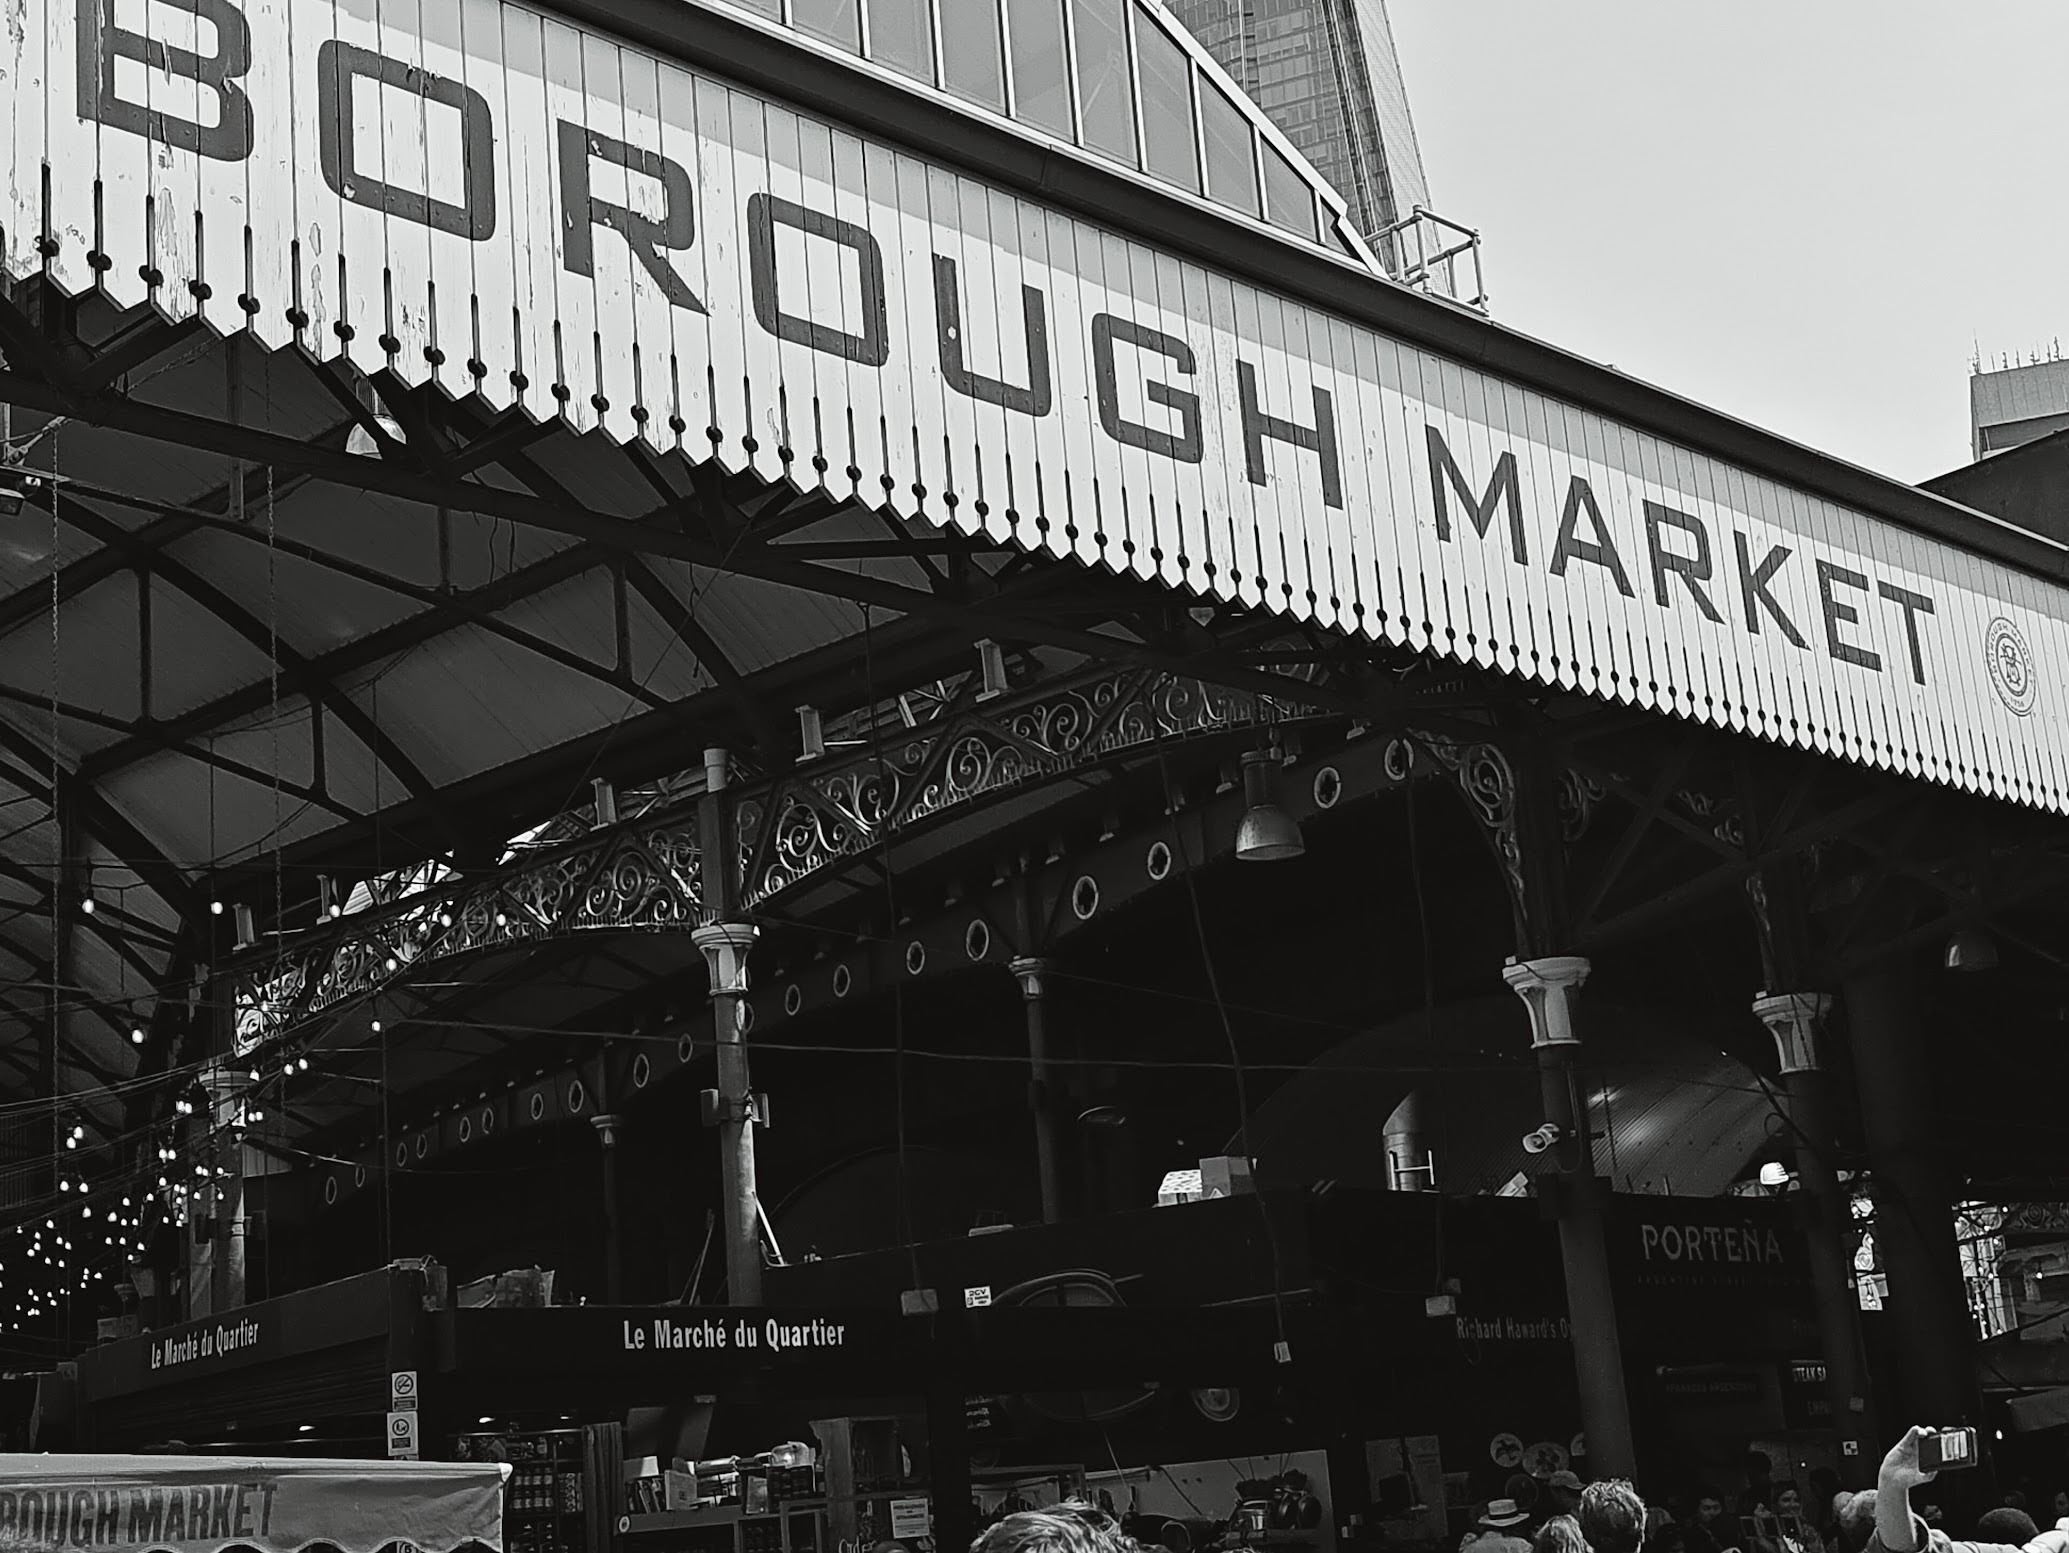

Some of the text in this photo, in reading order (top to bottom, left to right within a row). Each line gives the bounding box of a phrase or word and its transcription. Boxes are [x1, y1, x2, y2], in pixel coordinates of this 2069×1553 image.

[76, 0, 1936, 686] BOROUGH MARKET
[1641, 1218, 1784, 1263] PORTEÑA
[152, 1318, 259, 1369] Le Marché du Quartier
[623, 1317, 845, 1353] Le Marché du Quartier
[128, 1483, 277, 1543] MARKET
